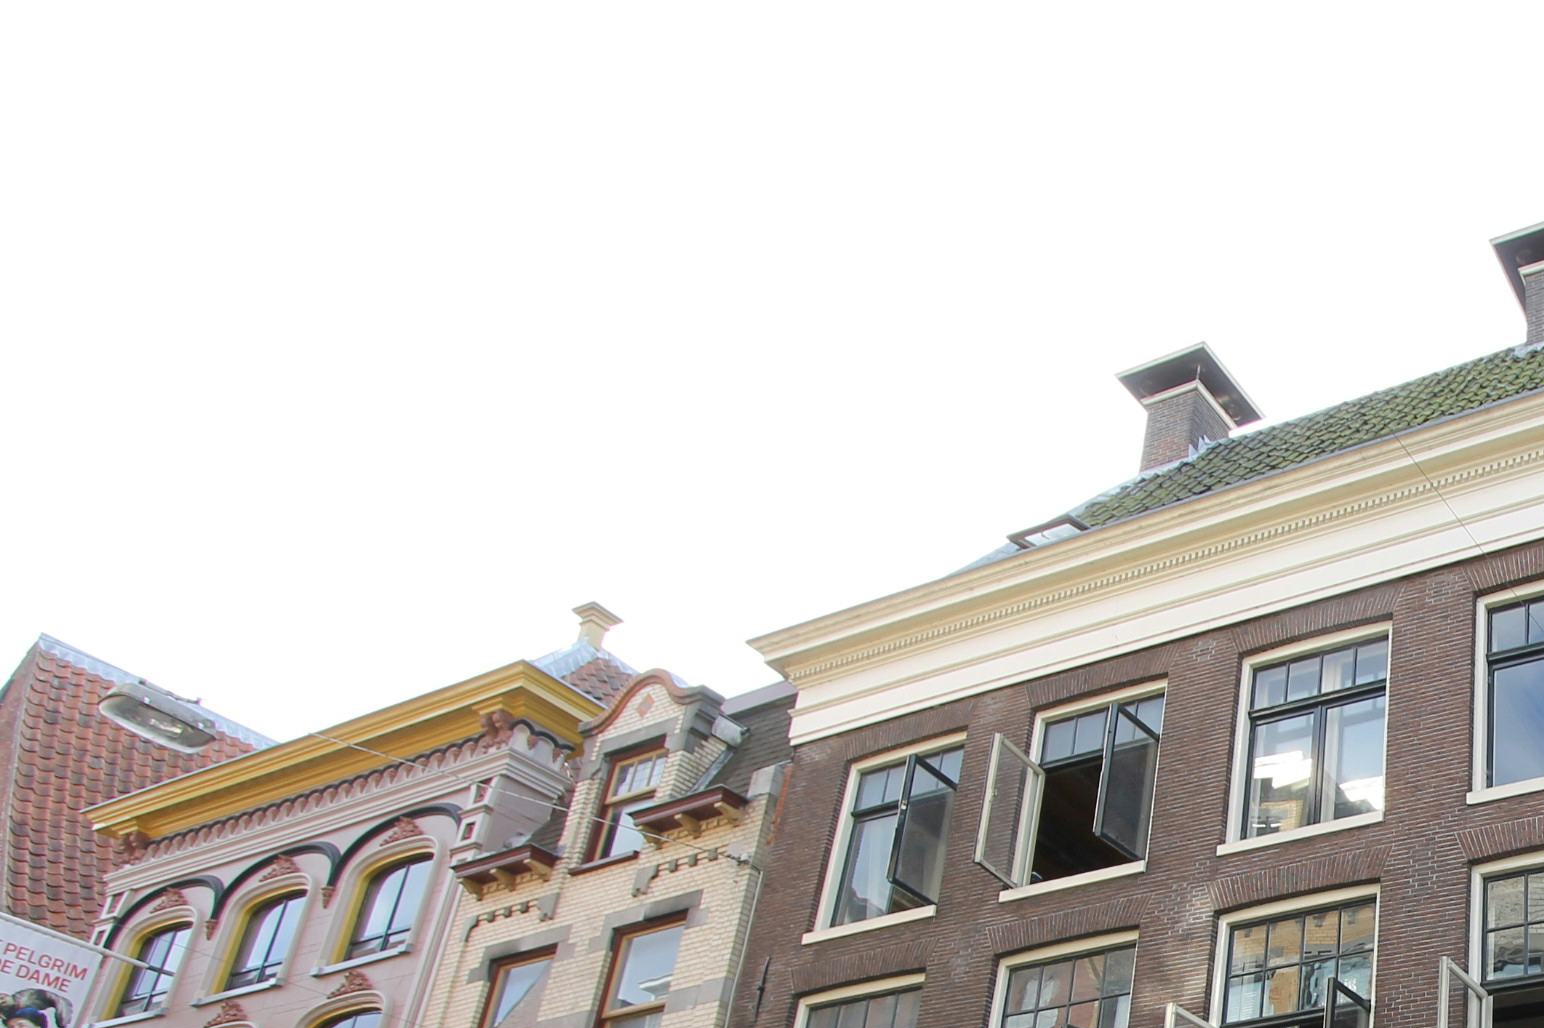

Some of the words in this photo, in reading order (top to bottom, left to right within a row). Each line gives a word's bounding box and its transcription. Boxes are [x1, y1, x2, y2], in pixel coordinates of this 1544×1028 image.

[0, 957, 15, 975] E
[16, 964, 72, 993] DAME
[3, 942, 88, 981] PELGRIM
